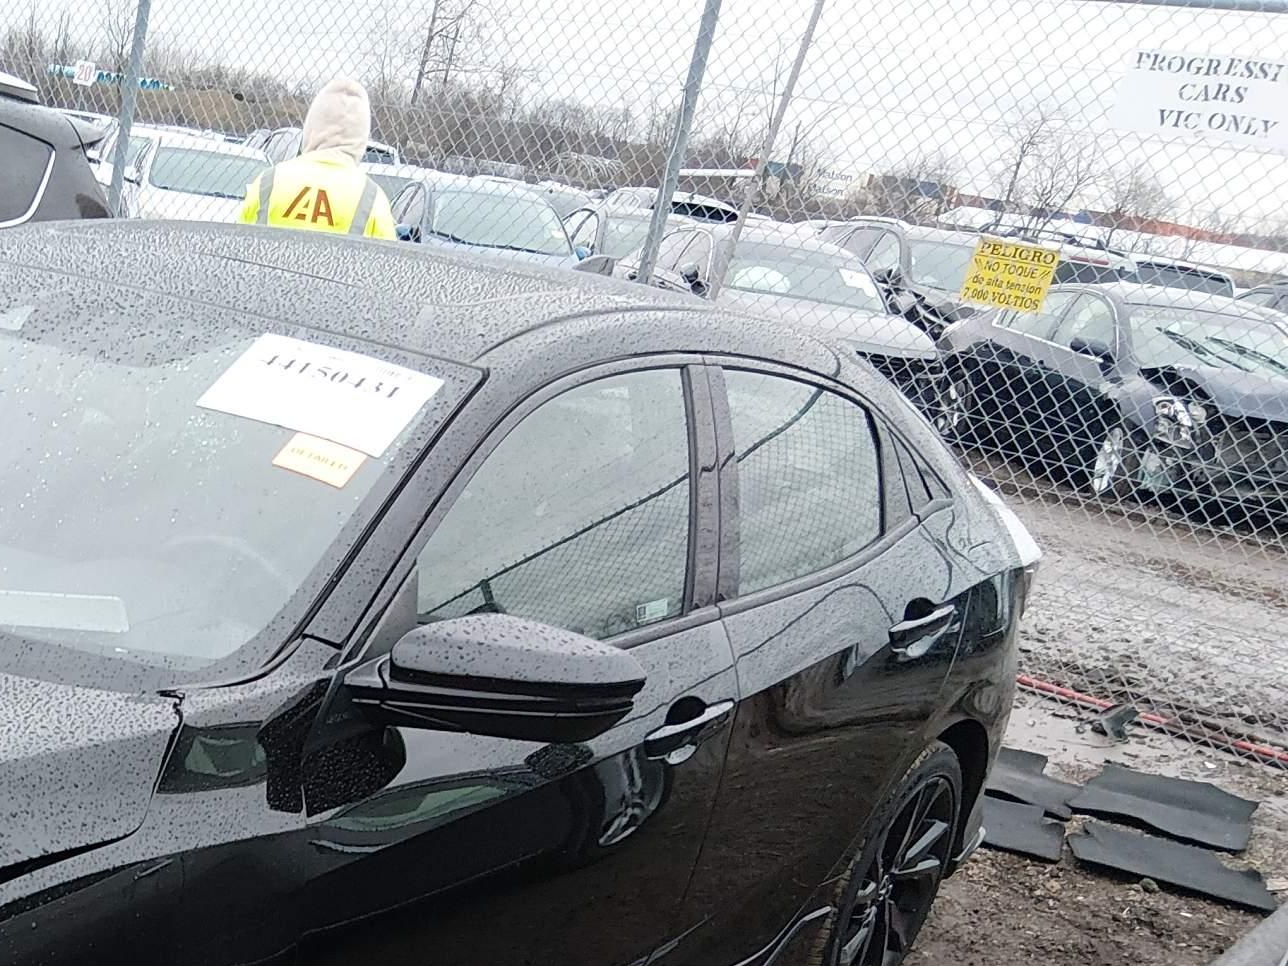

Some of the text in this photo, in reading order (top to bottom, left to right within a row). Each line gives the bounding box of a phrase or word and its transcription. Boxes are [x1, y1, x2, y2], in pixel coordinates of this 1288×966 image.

[1178, 83, 1249, 104] CARS
[1158, 108, 1280, 138] VIC ONLY
[980, 241, 1056, 265] PELIGRO
[972, 273, 985, 286] de
[983, 260, 1039, 279] NO TOQUE
[991, 291, 1041, 311] VOLTIOS
[260, 355, 401, 399] 44150431
